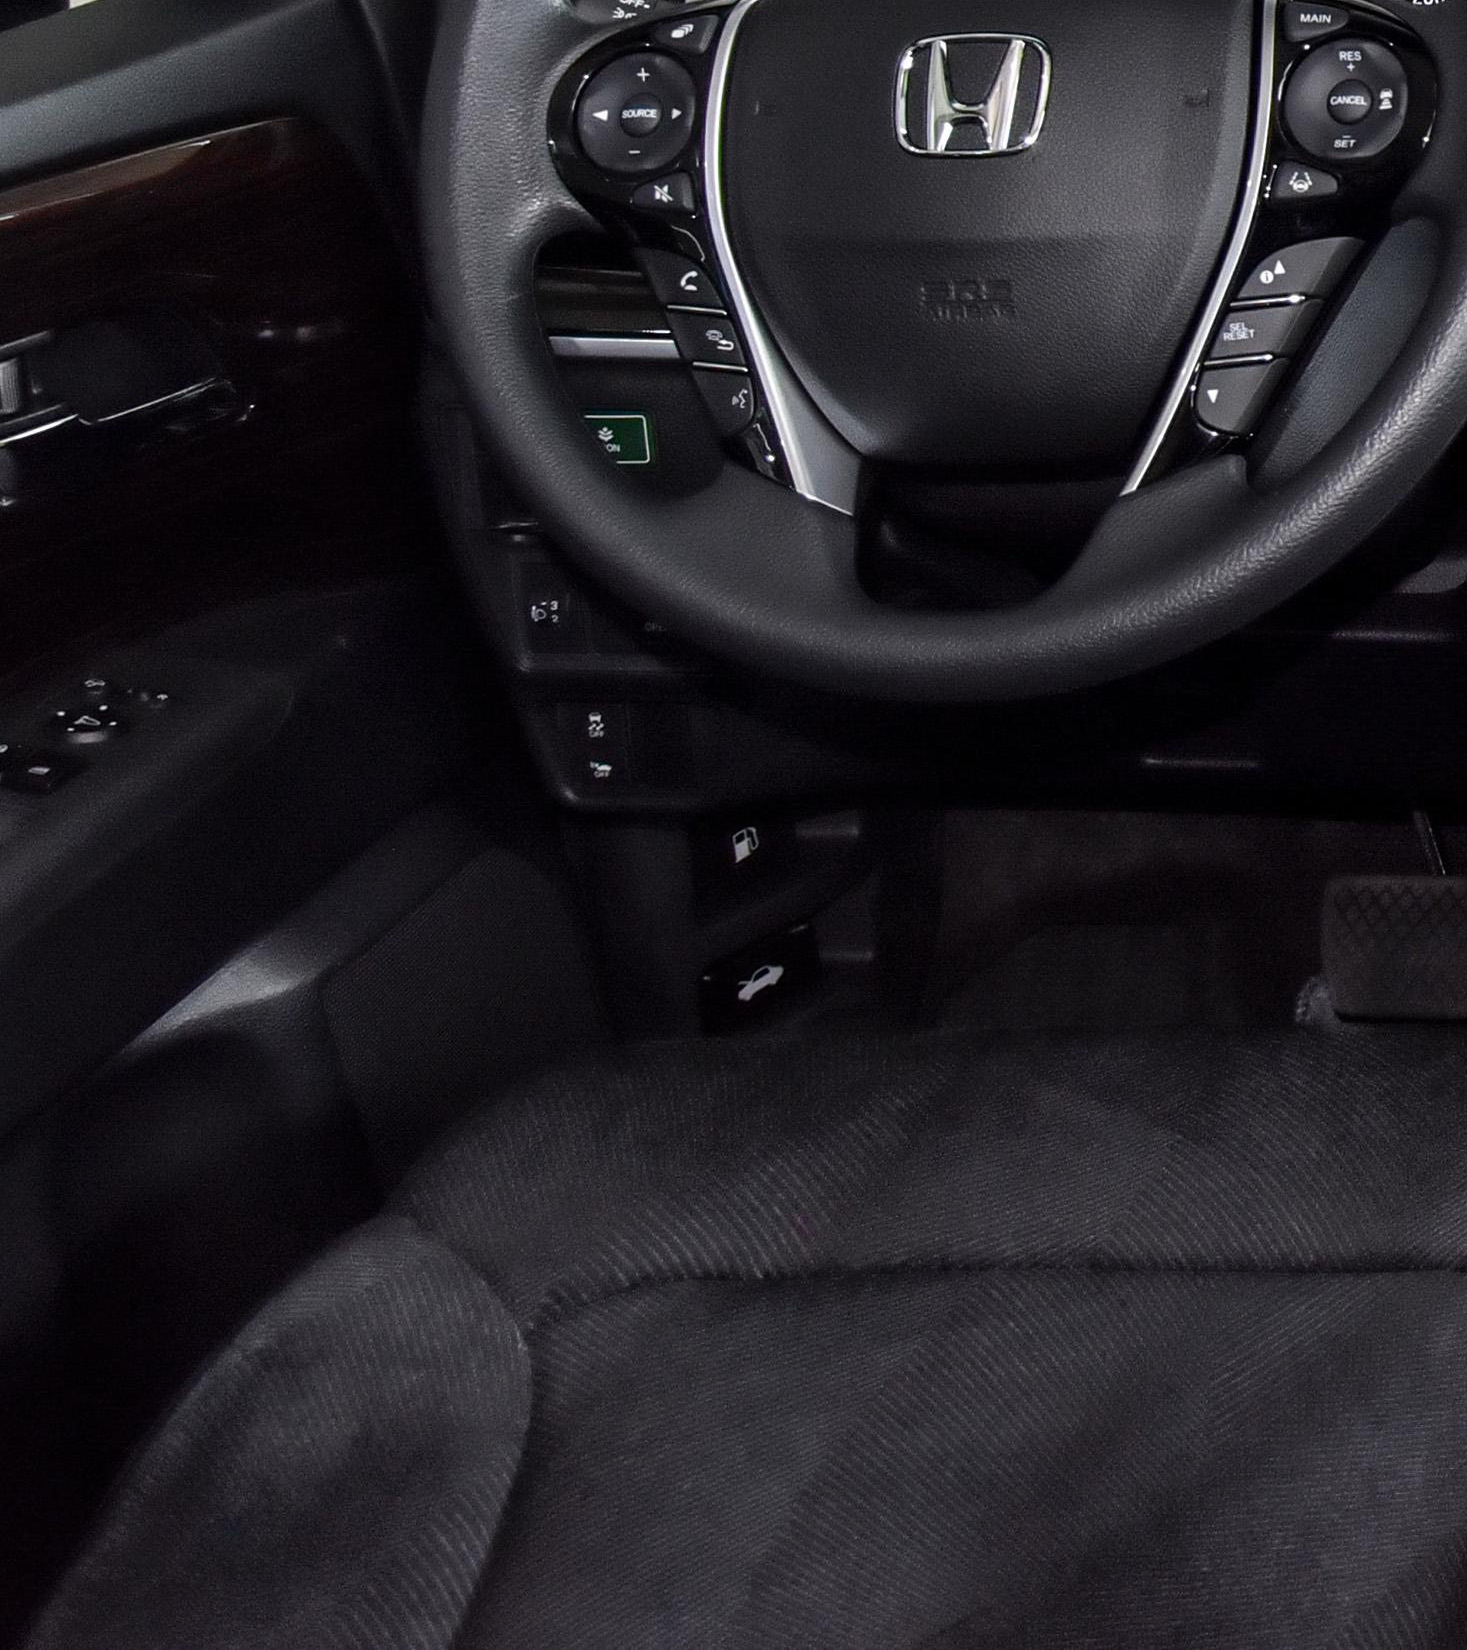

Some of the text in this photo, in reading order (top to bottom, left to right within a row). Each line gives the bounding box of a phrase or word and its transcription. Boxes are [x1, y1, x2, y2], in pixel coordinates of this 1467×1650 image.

[1300, 14, 1331, 23] MAIN
[1339, 50, 1362, 63] RES
[1331, 96, 1367, 105] CANCEL
[621, 108, 657, 118] SOURCE
[1334, 137, 1355, 147] SET
[1228, 321, 1248, 334] SEL
[1223, 328, 1255, 342] RESET
